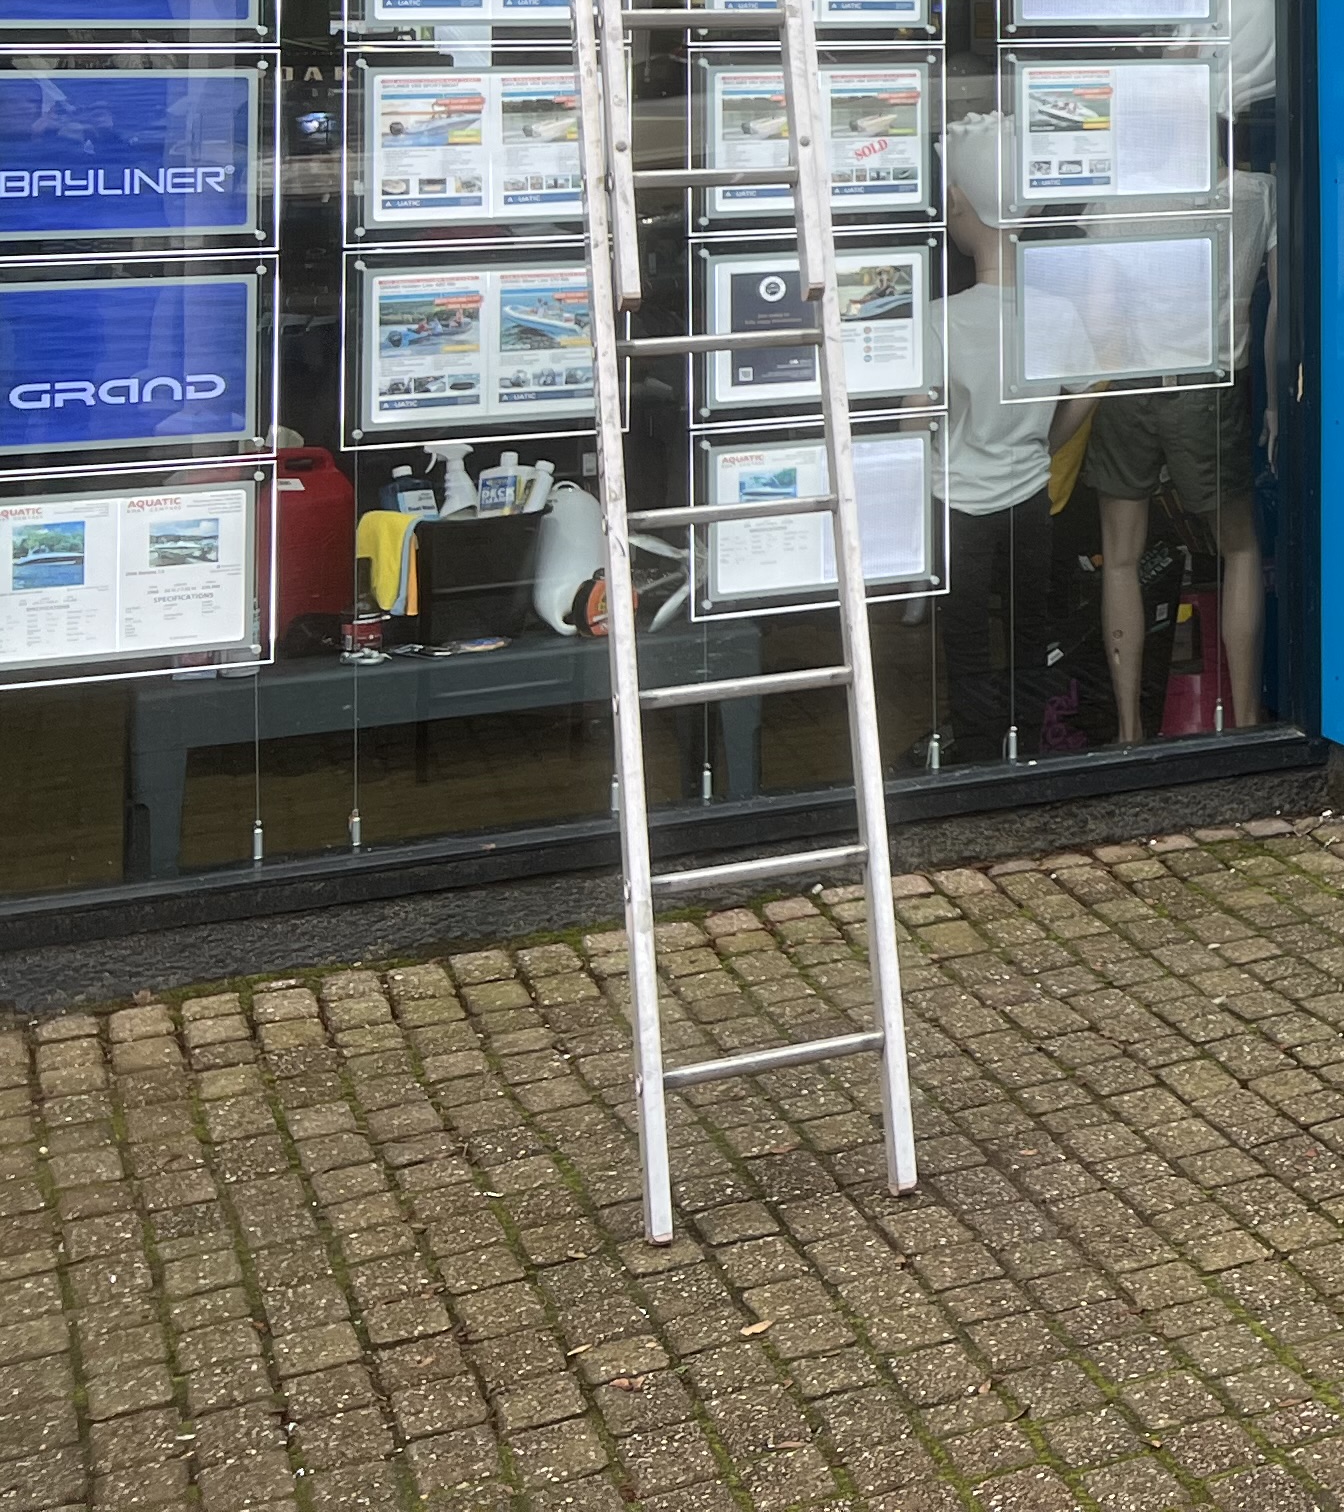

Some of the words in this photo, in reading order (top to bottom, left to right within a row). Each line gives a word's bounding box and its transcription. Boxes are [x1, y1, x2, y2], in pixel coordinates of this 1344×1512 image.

[854, 139, 888, 161] SOLD
[0, 167, 225, 198] BAYLINER
[9, 374, 226, 409] GRAND
[721, 454, 764, 465] AQUATIC
[127, 497, 182, 513] AQUATIC
[153, 592, 214, 604] SPECIFICATIONS
